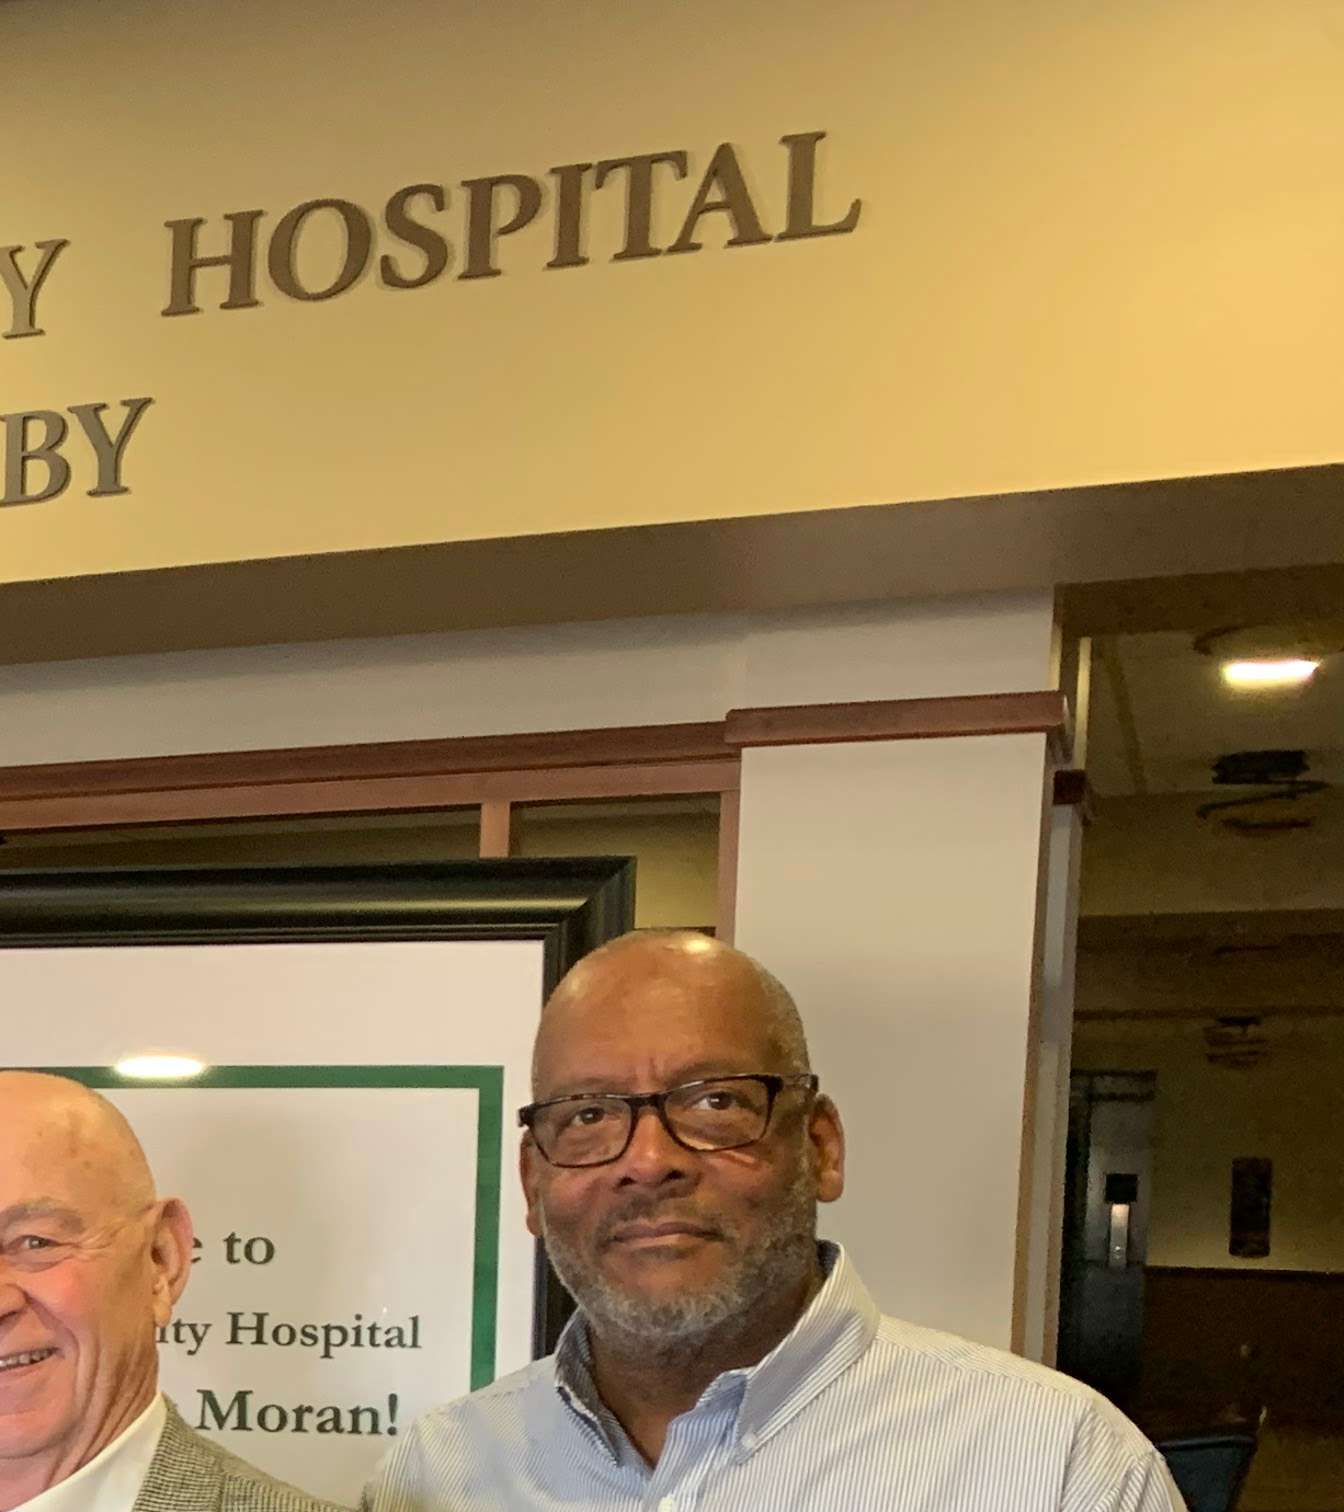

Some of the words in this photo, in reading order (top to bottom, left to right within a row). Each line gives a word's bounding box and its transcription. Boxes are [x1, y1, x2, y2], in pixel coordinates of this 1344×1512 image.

[160, 130, 862, 317] HOSPITAL
[223, 1231, 275, 1265] to
[225, 1311, 422, 1360] Hospital
[194, 1388, 399, 1437] Moran!
